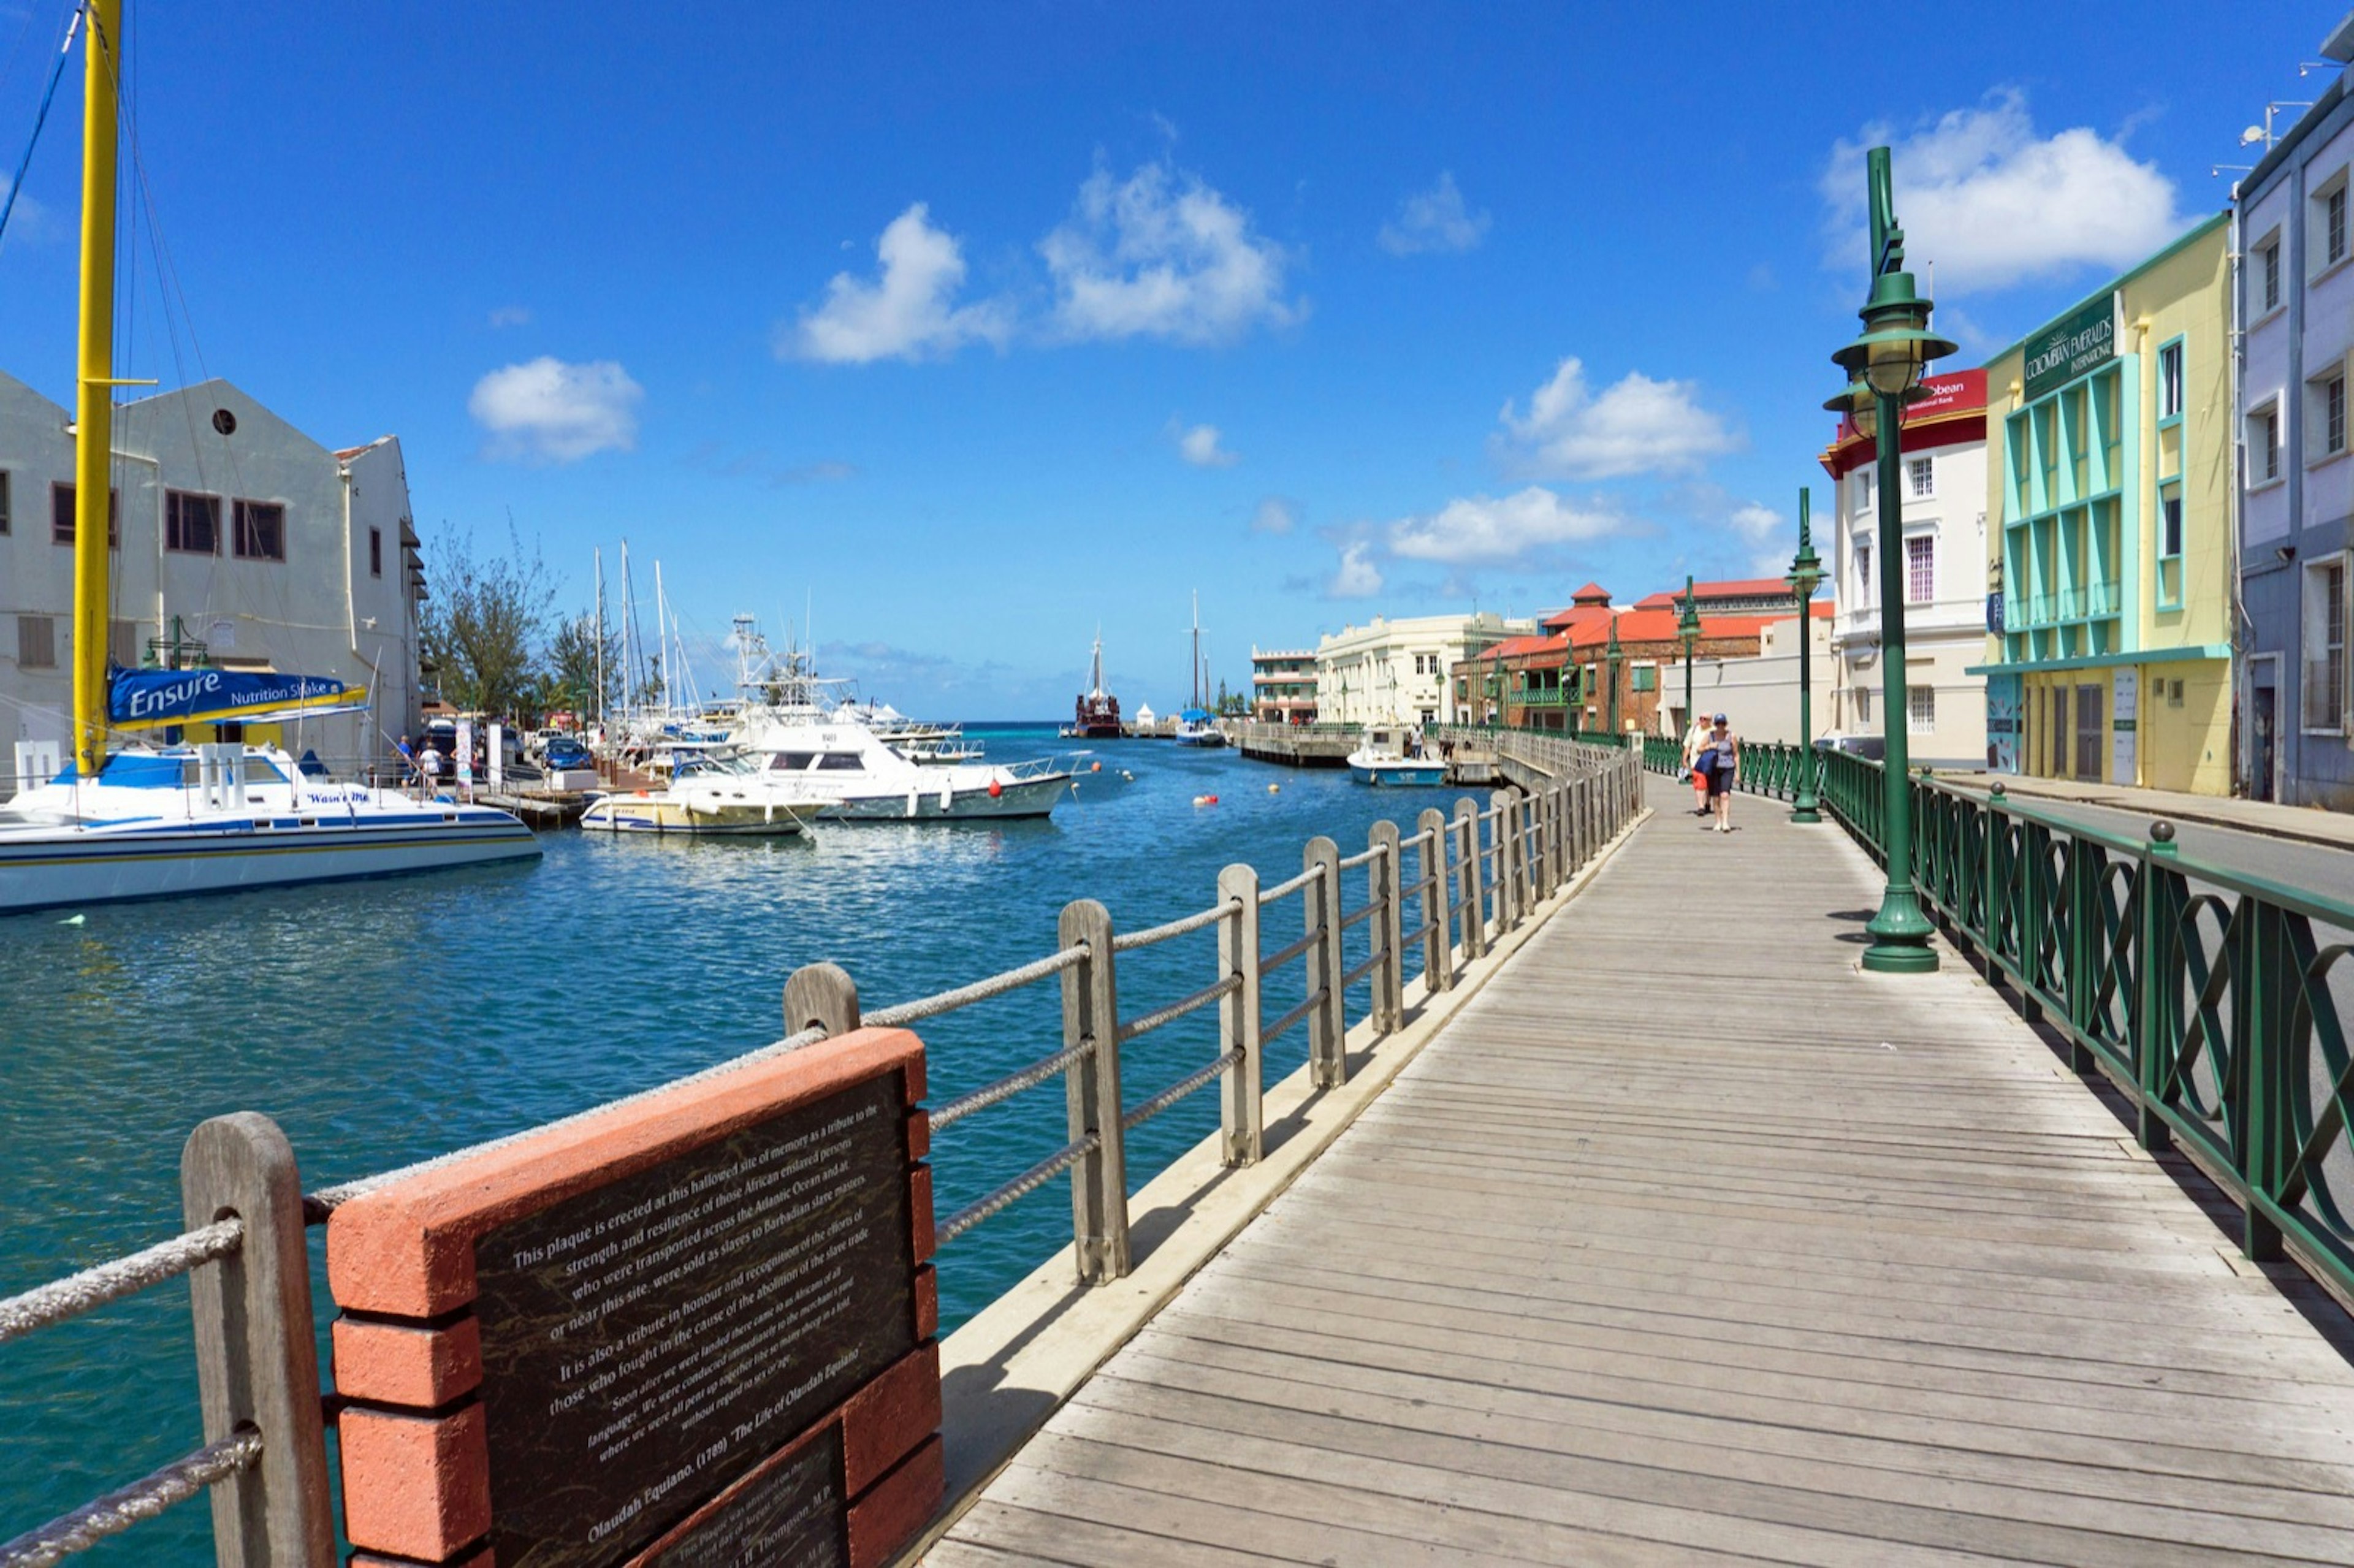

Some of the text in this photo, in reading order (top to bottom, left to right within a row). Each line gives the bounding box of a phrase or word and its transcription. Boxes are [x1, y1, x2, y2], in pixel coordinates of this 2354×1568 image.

[2025, 316, 2112, 381] COLOMBIAN EMERALDS
[1939, 396, 1954, 405] Bank
[130, 672, 222, 718] Ensure
[231, 682, 327, 706] Nutrition Shake
[352, 791, 370, 802] Me
[513, 1104, 878, 1269] This plaque is erected at this hallowed site of memory as a tribute to the
[565, 1138, 852, 1276] strength and resilience of those African enslaved persons
[571, 1278, 601, 1301] who
[603, 1263, 633, 1285] were
[636, 1231, 701, 1268] transported
[703, 1216, 736, 1238] across
[736, 1206, 754, 1223] the
[755, 1186, 791, 1212] Atlantic
[792, 1173, 821, 1195] Ocean
[821, 1163, 839, 1180] and
[550, 1323, 565, 1340] or
[568, 1306, 599, 1331] near
[601, 1295, 625, 1315] this
[653, 1266, 680, 1288] were
[683, 1249, 707, 1273] sold
[708, 1248, 720, 1262] as
[720, 1233, 750, 1255] slaves
[752, 1227, 763, 1239] to
[764, 1200, 810, 1232] Barbadian
[811, 1189, 833, 1207] slave
[560, 1206, 864, 1382] It is also a tribute in honour and recognition of the efforts of
[549, 1387, 585, 1417] those
[588, 1370, 616, 1395] who
[618, 1346, 658, 1378] fought
[660, 1339, 672, 1355] in
[674, 1327, 693, 1346] the
[693, 1309, 725, 1335] cause
[725, 1300, 737, 1316] of
[738, 1292, 755, 1311] the
[756, 1268, 798, 1300] abolition
[799, 1260, 810, 1276] of
[810, 1254, 825, 1268] the
[826, 1239, 847, 1260] slave
[639, 1374, 663, 1394] after
[663, 1366, 677, 1379] we
[678, 1352, 701, 1370] were
[701, 1331, 730, 1357] landed
[753, 1307, 775, 1326] came
[823, 1271, 832, 1284] of
[832, 1266, 841, 1279] all
[642, 1398, 657, 1413] We
[658, 1383, 681, 1404] were
[682, 1354, 727, 1390] conducted
[681, 1402, 715, 1431] without
[715, 1382, 743, 1410] regard
[587, 1496, 642, 1543] Olaudah
[696, 1436, 728, 1469] (1789)
[754, 1406, 773, 1428] Life
[774, 1396, 785, 1415] of
[785, 1371, 824, 1406] Olaudah
[600, 1437, 631, 1463] where
[632, 1428, 645, 1441] we
[648, 1412, 671, 1431] were
[672, 1401, 684, 1417] all
